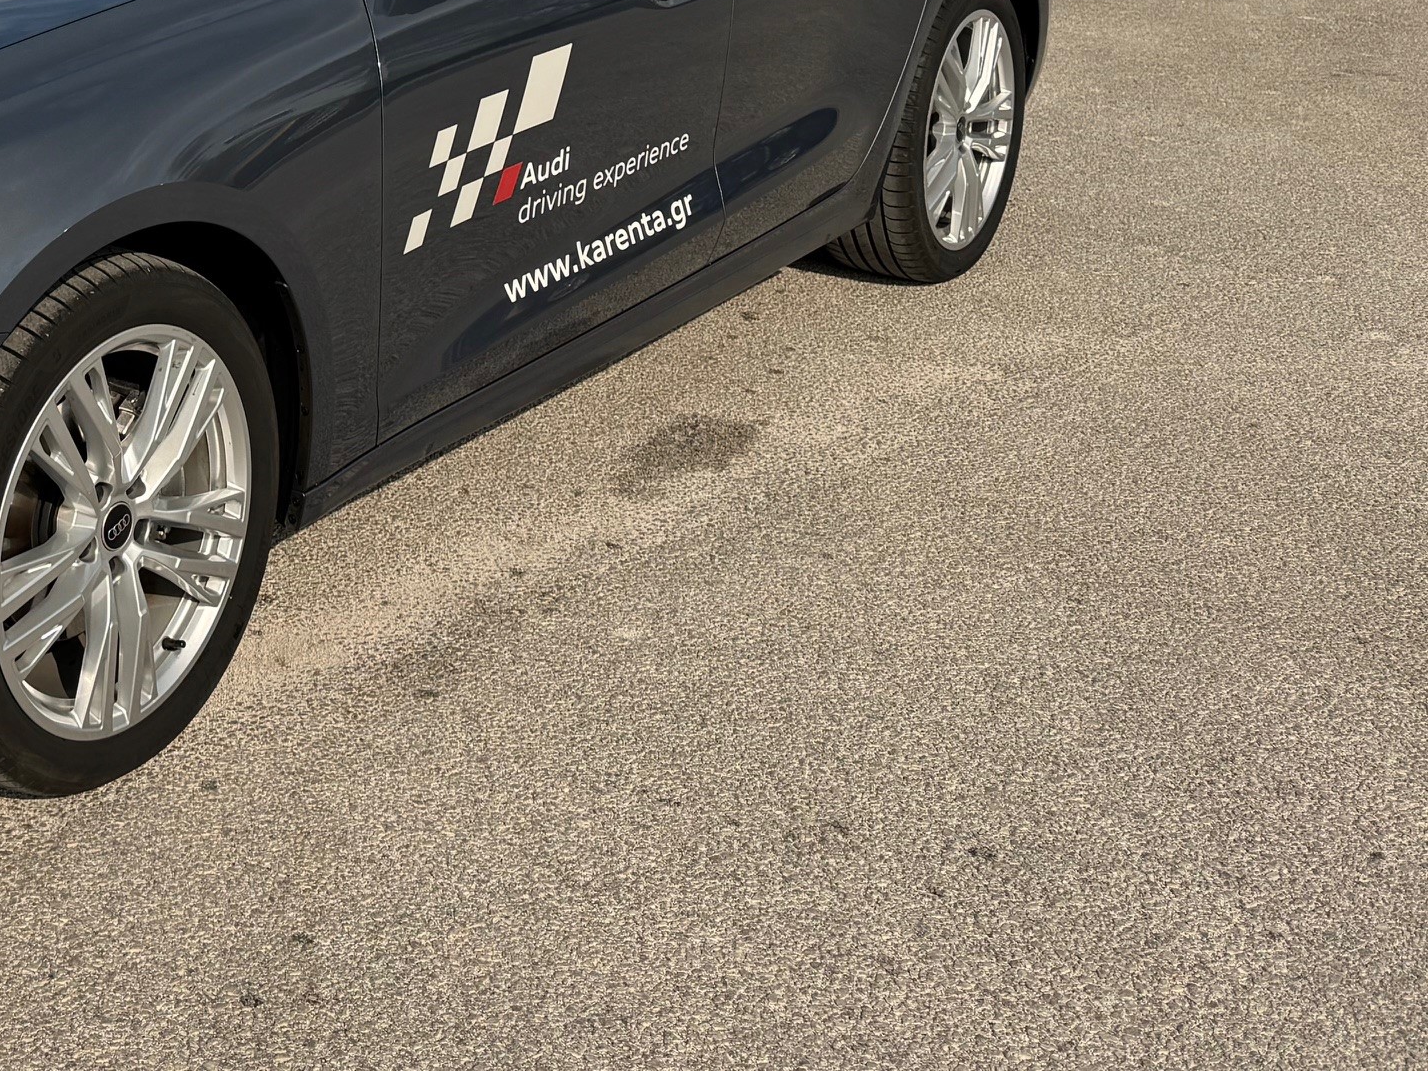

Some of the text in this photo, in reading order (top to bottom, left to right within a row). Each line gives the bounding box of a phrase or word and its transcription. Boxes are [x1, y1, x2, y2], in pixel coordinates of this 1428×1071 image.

[518, 133, 690, 224] driving experience
[520, 146, 571, 190] Audi
[503, 193, 693, 303] www.karenta.gr
